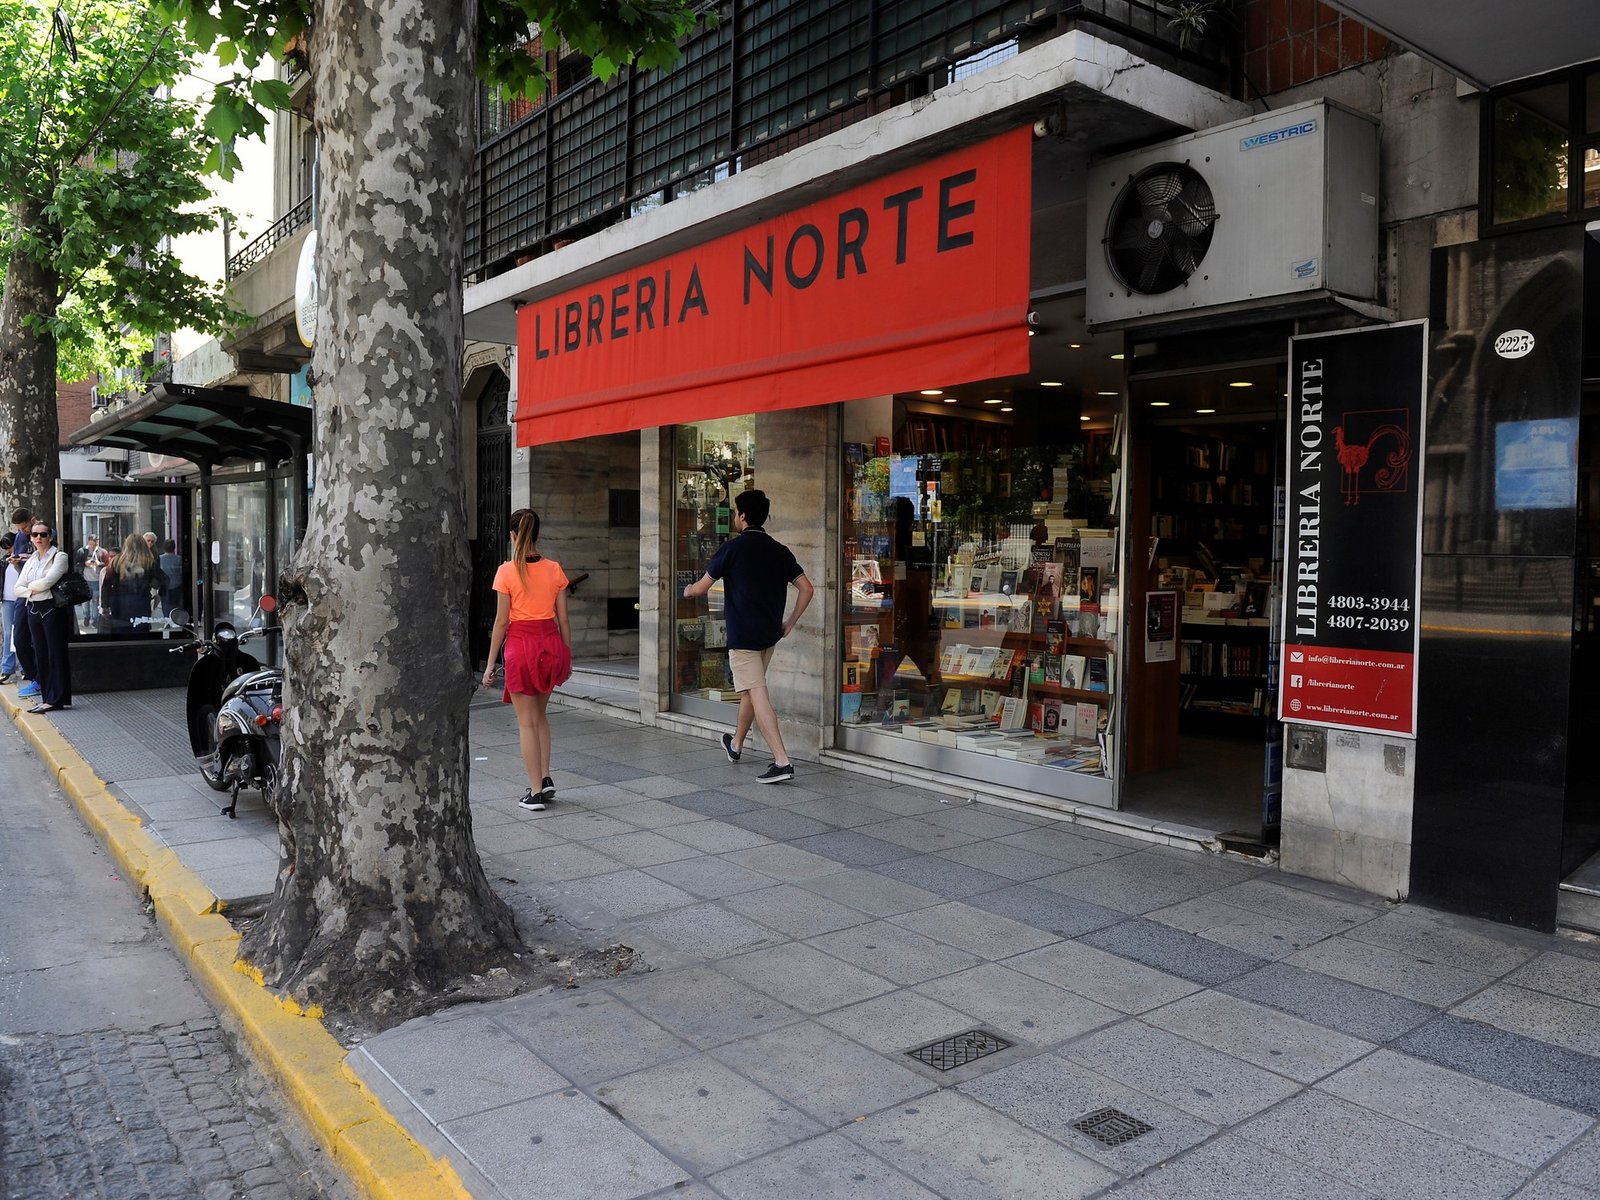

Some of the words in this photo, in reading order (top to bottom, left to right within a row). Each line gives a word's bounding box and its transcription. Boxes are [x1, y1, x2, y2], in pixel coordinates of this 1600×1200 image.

[1243, 122, 1314, 149] WESTRIC
[535, 262, 708, 360] LIBRERIA
[743, 168, 977, 305] NORTE
[1497, 336, 1530, 353] 2223
[1300, 357, 1324, 473] NORTE
[678, 472, 704, 485] EVITA
[1295, 480, 1322, 638] LIBRERIA
[1327, 595, 1410, 611] 4803-3944
[1327, 615, 1410, 632] 4807-2039
[1308, 655, 1405, 670] info@librerianorte.com.ar
[1307, 679, 1355, 691] /librerianorte
[1306, 704, 1399, 720] www.librerianorte.com.ar
